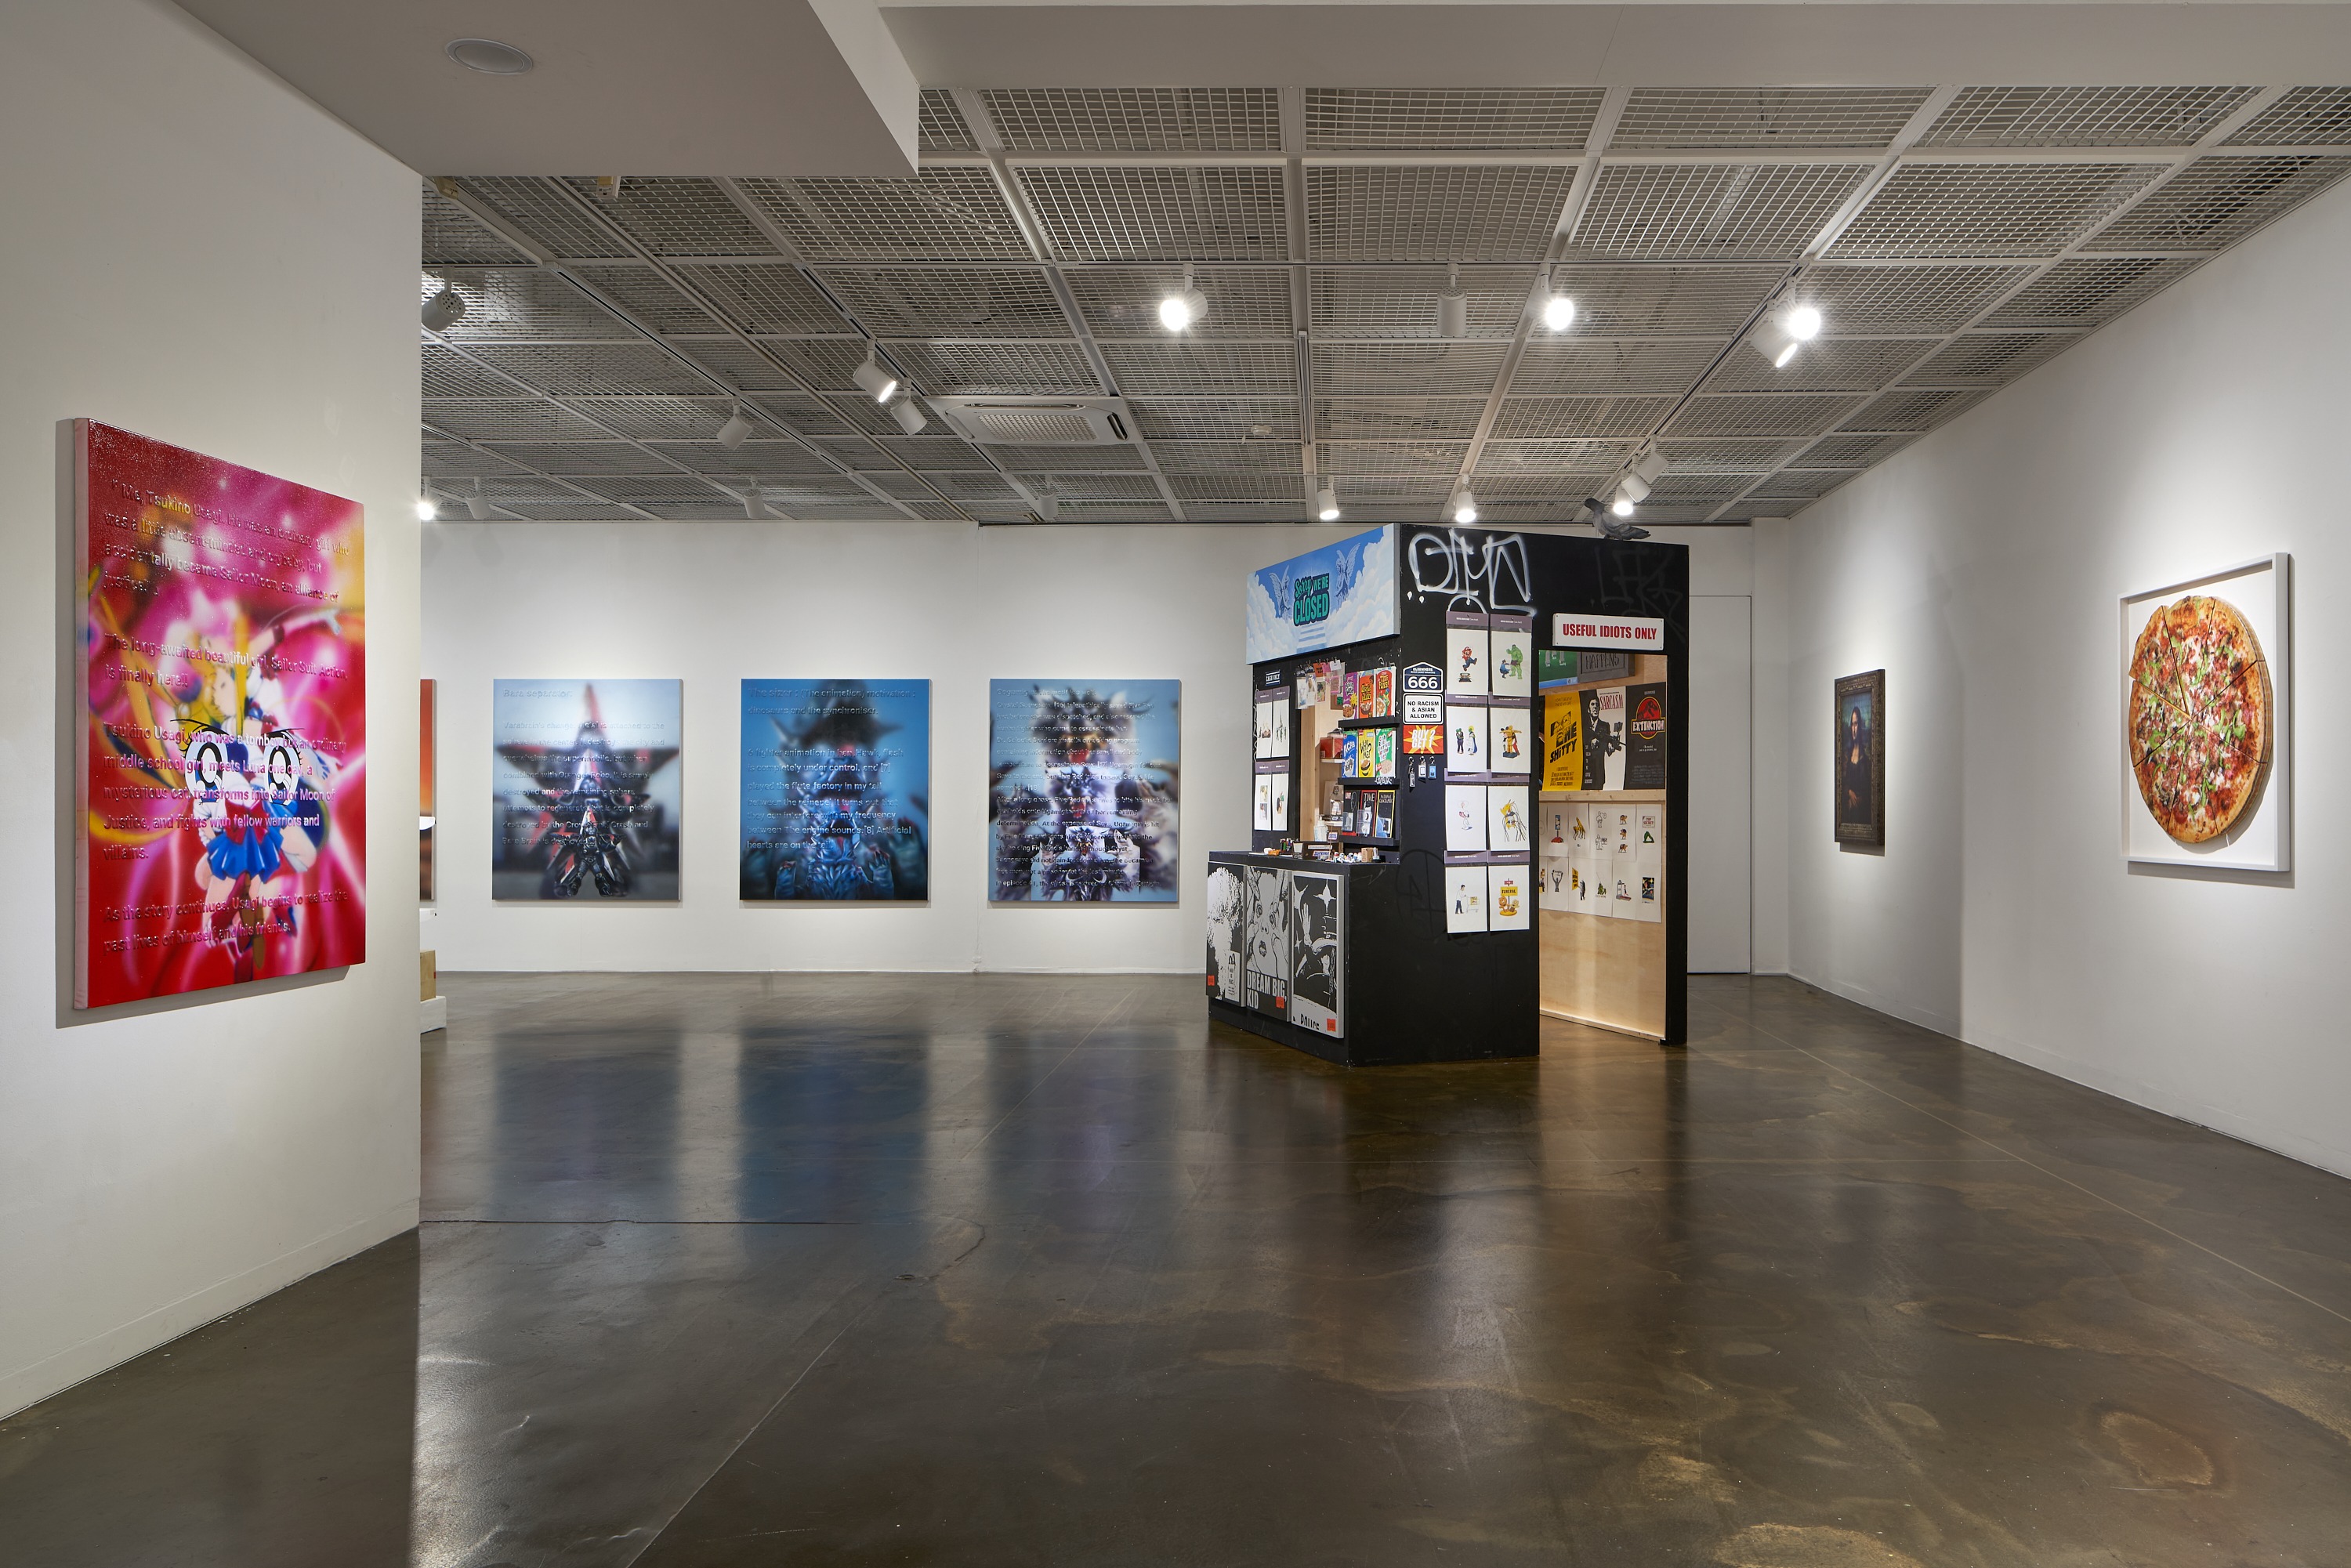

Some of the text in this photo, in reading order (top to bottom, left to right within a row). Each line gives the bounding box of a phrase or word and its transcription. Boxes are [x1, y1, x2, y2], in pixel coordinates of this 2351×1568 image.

[147, 489, 191, 515] Tsukino
[1295, 579, 1312, 599] Sorry
[1295, 593, 1329, 625] CLOSED
[1563, 623, 1657, 640] USEFUL IDIOTS ONLY
[130, 636, 203, 661] long-awaited
[270, 655, 299, 673] Sailor
[1585, 653, 1620, 670] HAPPENS
[105, 663, 116, 680] is
[118, 664, 155, 687] finally
[1407, 675, 1438, 690] 666
[1599, 694, 1624, 711] SARCASM
[1411, 729, 1429, 739] BUY
[1632, 719, 1665, 732] EXTINCTION
[190, 730, 212, 744] who
[215, 733, 234, 745] was
[1411, 738, 1427, 748] GET
[784, 748, 826, 758] animation
[103, 753, 145, 769] middle
[147, 755, 185, 771] school
[208, 759, 241, 773] meets
[243, 759, 267, 774] Luna
[269, 762, 286, 774] one
[306, 764, 313, 776] a
[803, 763, 828, 772] under
[103, 785, 168, 802] mysterious
[193, 785, 249, 801] transforms
[251, 785, 270, 800] into
[299, 788, 324, 801] Moon
[325, 788, 336, 802] of
[542, 787, 556, 795] and
[813, 781, 843, 791] factory
[844, 781, 853, 790] in
[853, 782, 868, 792] my
[784, 798, 797, 806] the
[1364, 793, 1375, 802] TIME
[103, 813, 321, 831] Justice, and fights with fellow warriors and
[840, 812, 854, 821] my
[854, 811, 897, 821] frequency
[802, 826, 830, 836] engine
[864, 825, 875, 835] [8]
[103, 843, 150, 861] villains.
[746, 840, 773, 849] hearts
[231, 896, 259, 911] Usagi
[261, 892, 293, 907] begins
[294, 892, 304, 906] to
[237, 922, 254, 939] his
[1247, 970, 1271, 995] DREAM
[1247, 988, 1259, 1010] KID
